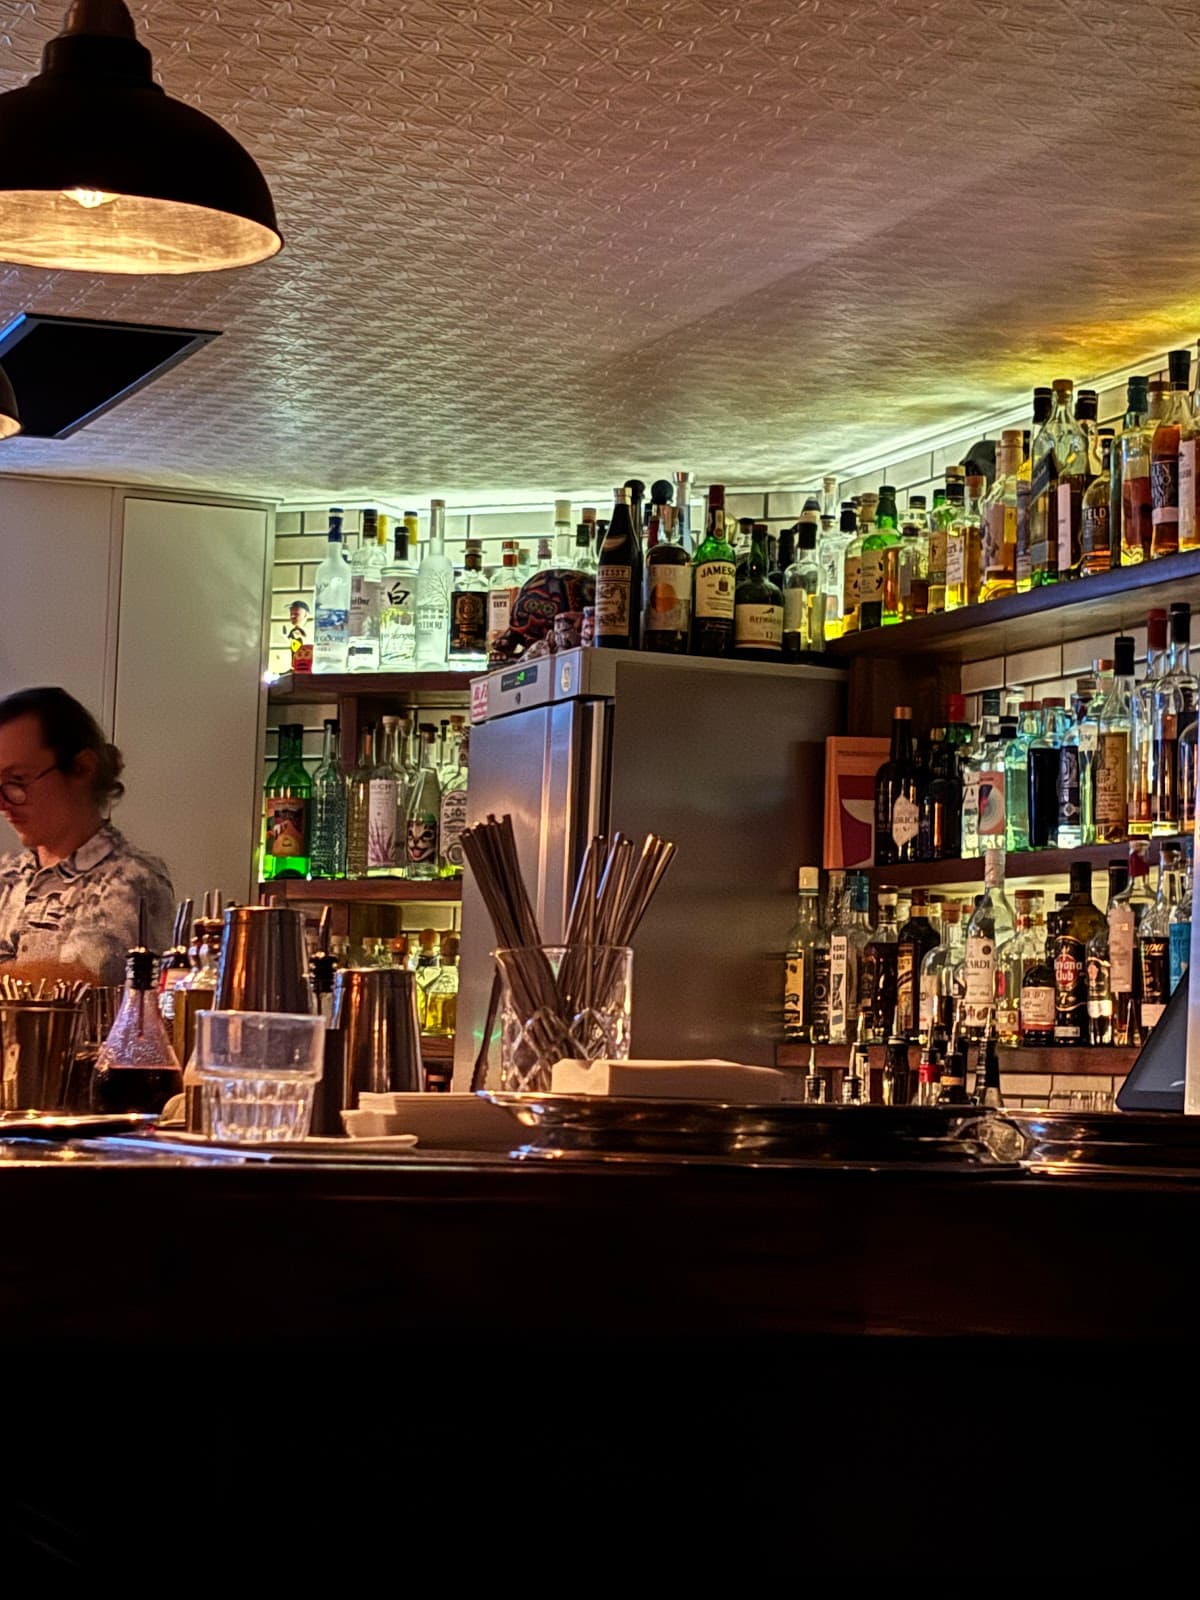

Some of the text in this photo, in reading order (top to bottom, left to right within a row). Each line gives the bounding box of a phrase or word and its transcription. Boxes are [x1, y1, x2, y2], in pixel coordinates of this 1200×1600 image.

[700, 566, 736, 578] JAMES
[387, 582, 410, 605] 白
[1056, 970, 1075, 981] Club
[1060, 991, 1068, 1005] 7
